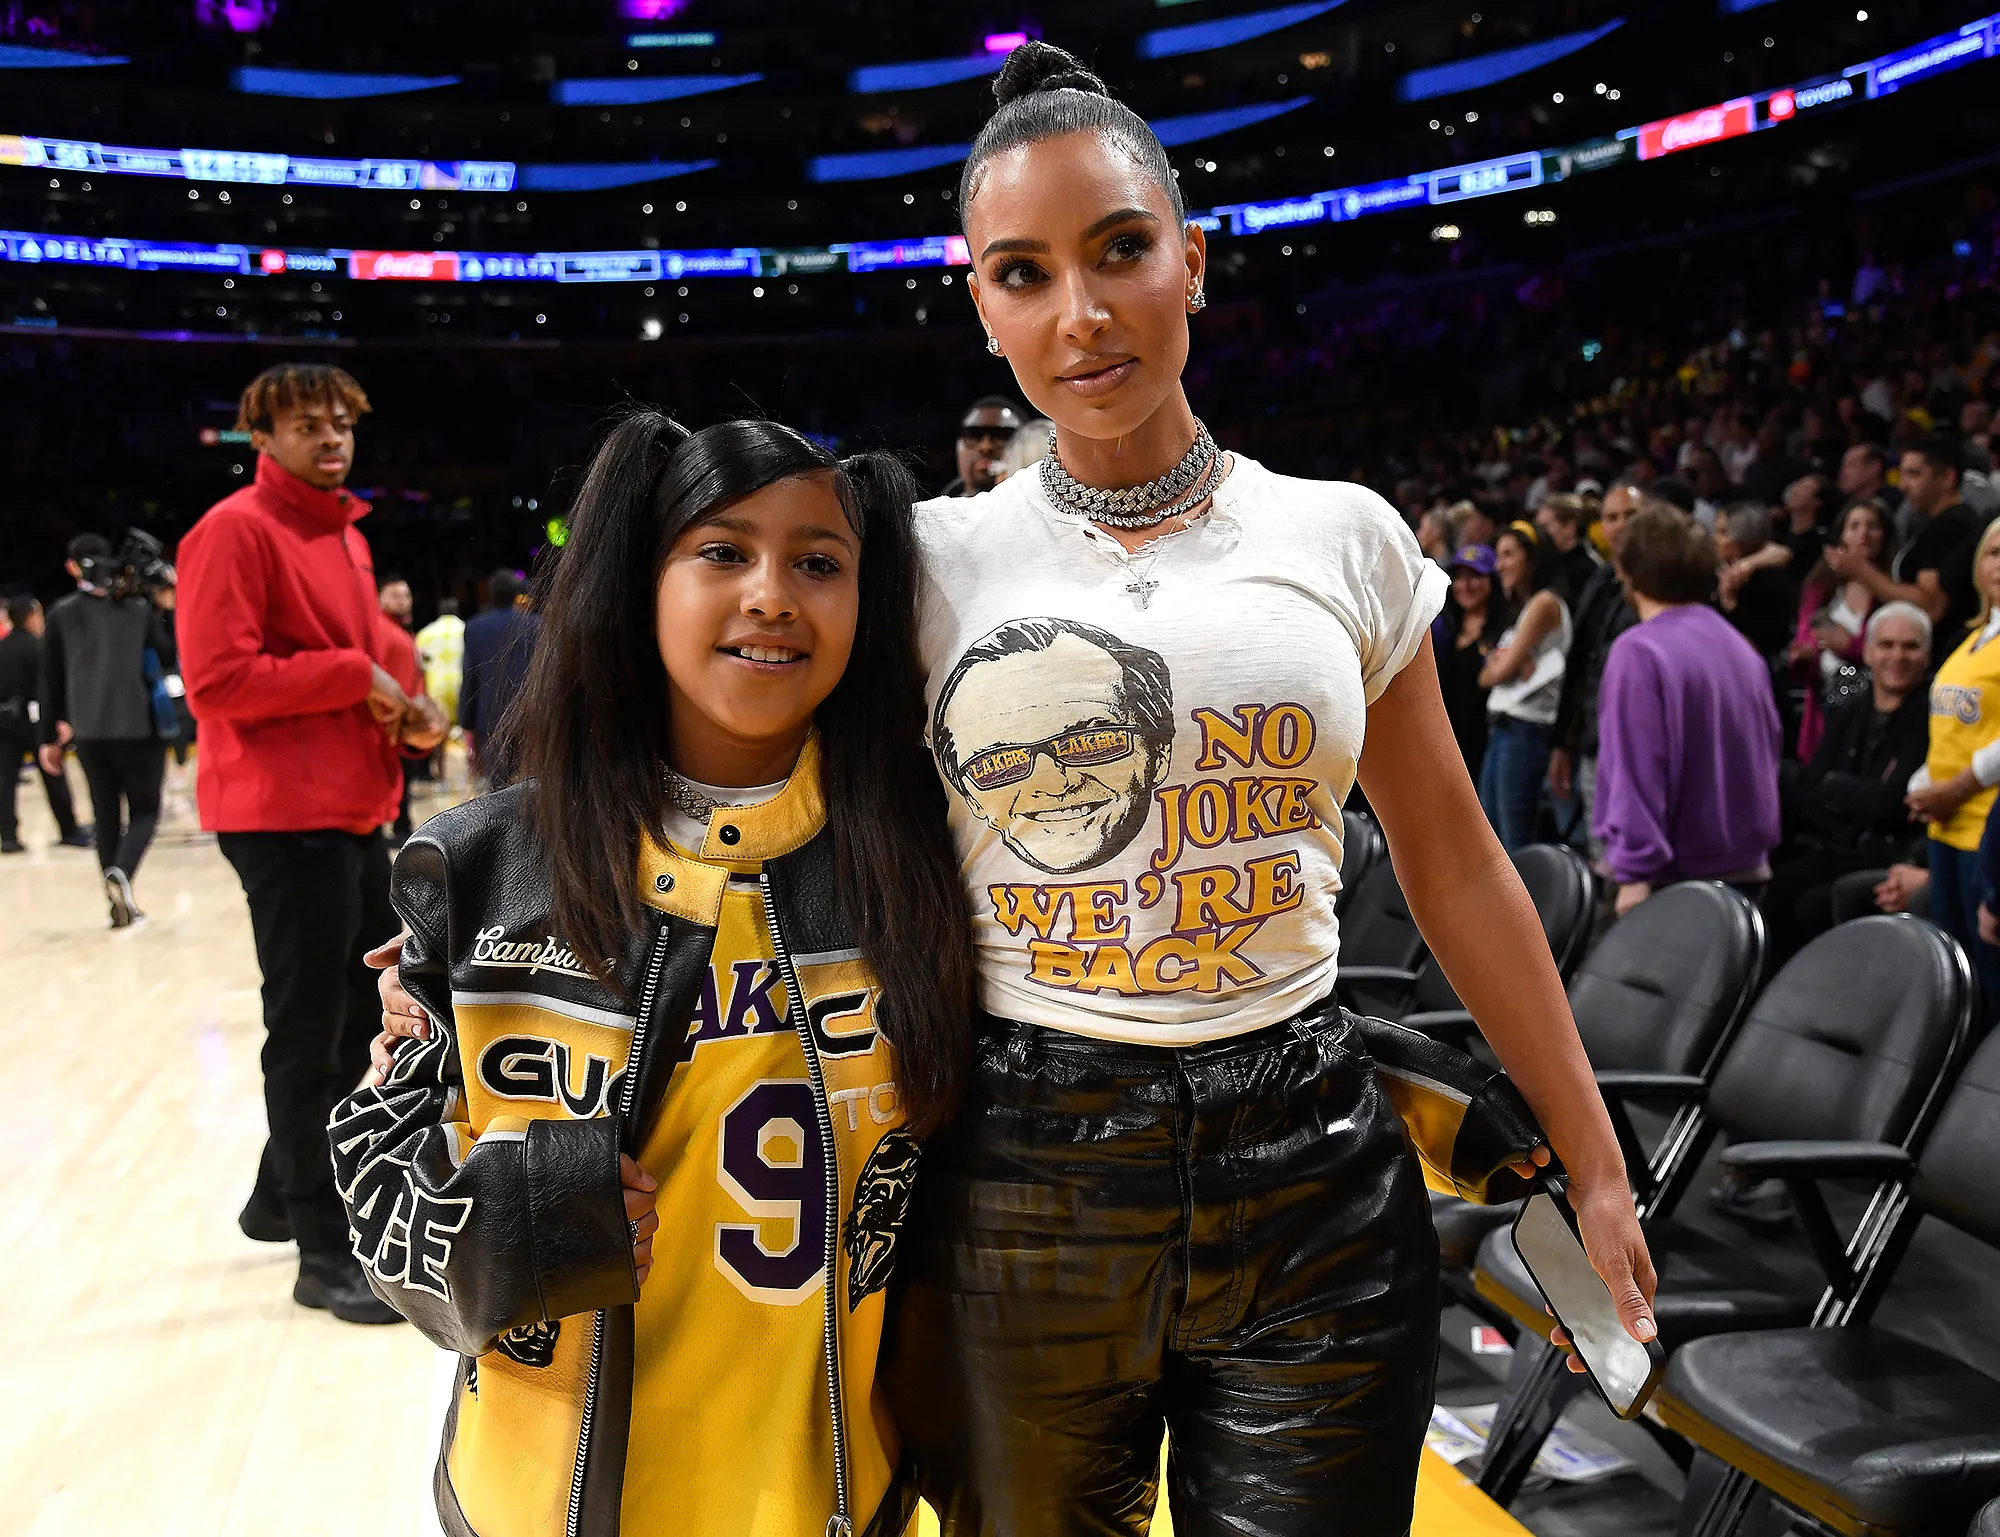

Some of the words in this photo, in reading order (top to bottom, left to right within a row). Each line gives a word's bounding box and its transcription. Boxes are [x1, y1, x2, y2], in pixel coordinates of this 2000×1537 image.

[970, 748, 1030, 779] LAKERS
[1052, 730, 1127, 757] LAKERS
[1192, 702, 1316, 771] NO
[1150, 777, 1322, 871] JOKE
[988, 850, 1305, 942] WE'RE
[1026, 915, 1267, 996] BACK
[478, 1035, 630, 1118] GU
[714, 1078, 828, 1306] 9
